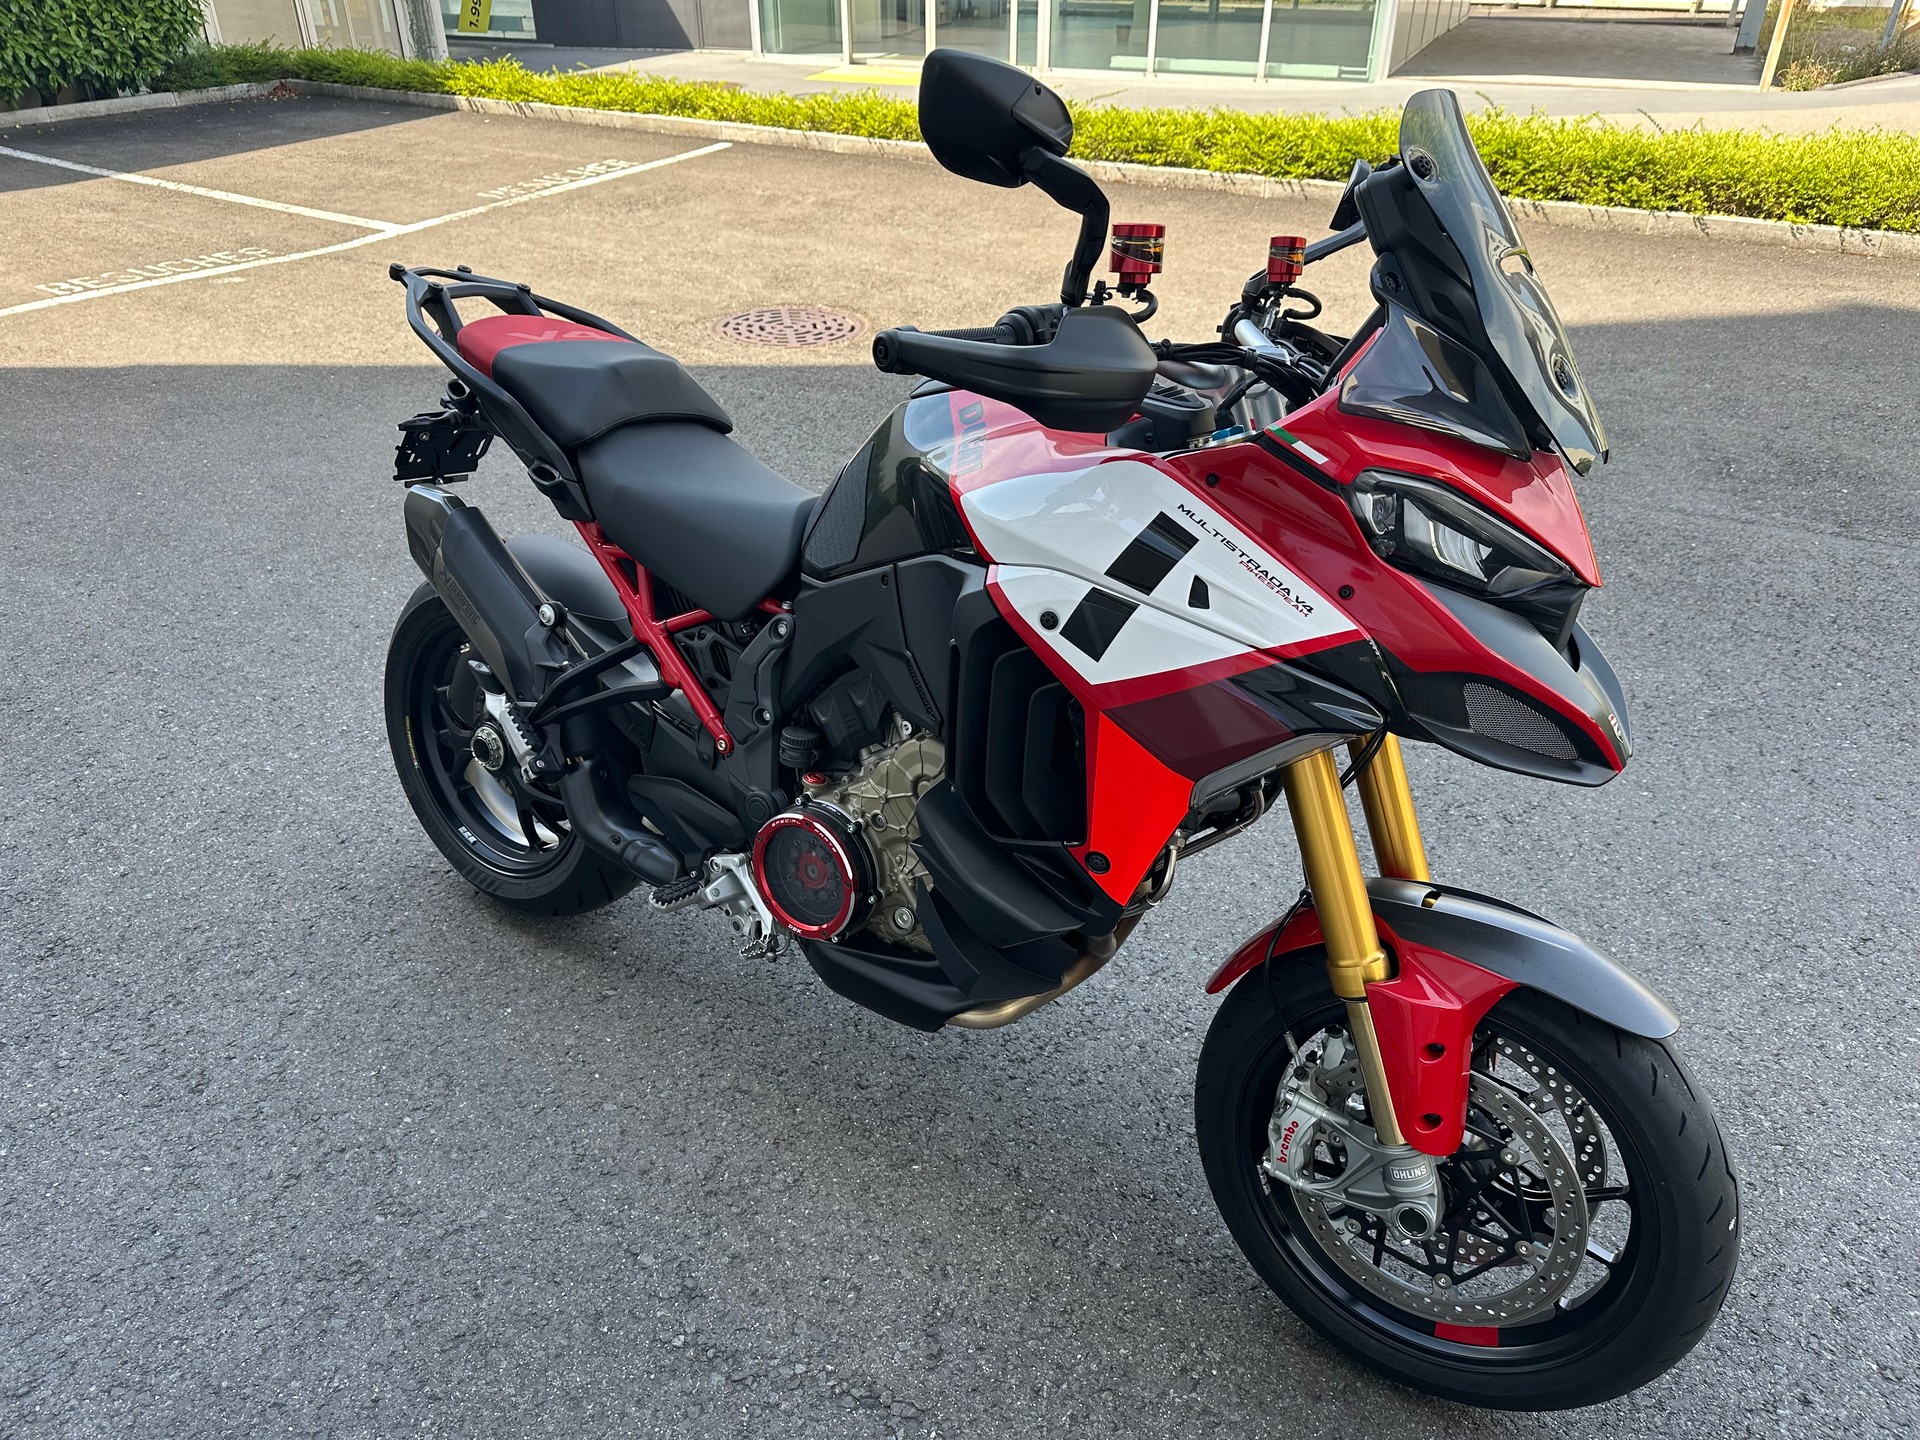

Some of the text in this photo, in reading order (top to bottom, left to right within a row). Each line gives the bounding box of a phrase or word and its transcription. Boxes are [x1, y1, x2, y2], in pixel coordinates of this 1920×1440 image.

[34, 246, 272, 296] BESUCHER
[1177, 503, 1314, 614] MULTISTRADA V4
[1239, 560, 1310, 618] PIKES PEAK
[1276, 1120, 1299, 1164] brembo
